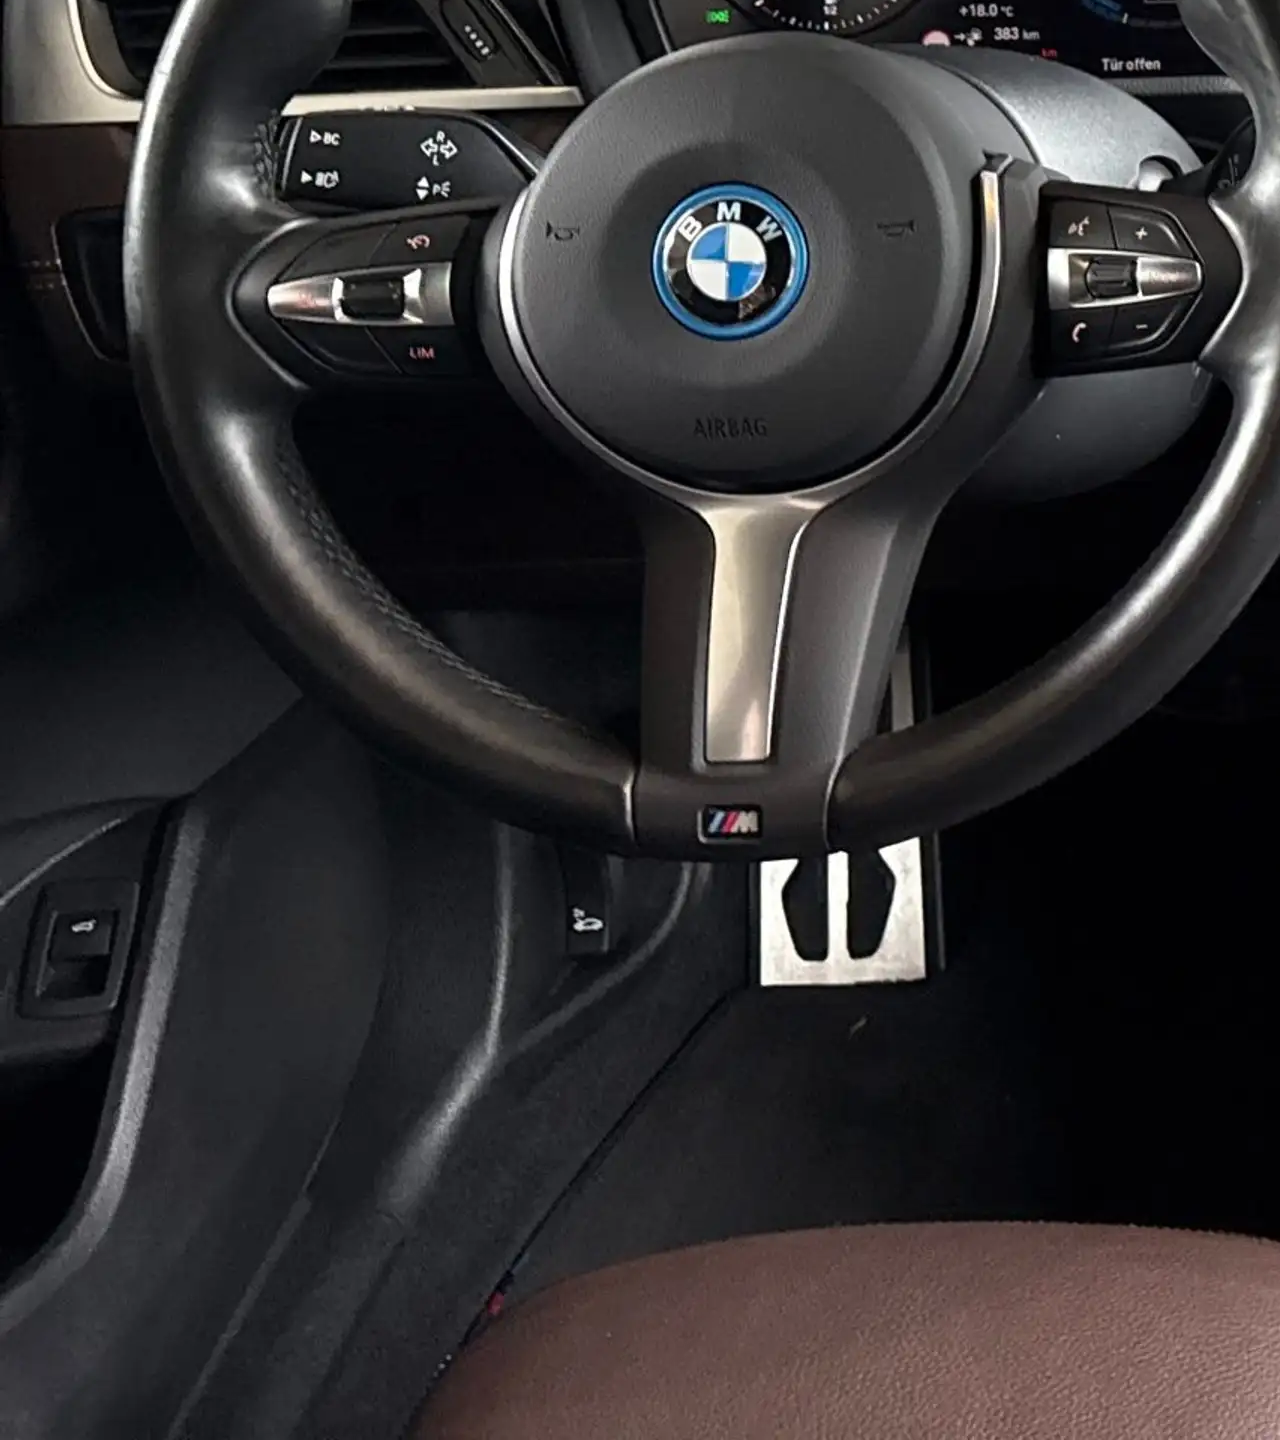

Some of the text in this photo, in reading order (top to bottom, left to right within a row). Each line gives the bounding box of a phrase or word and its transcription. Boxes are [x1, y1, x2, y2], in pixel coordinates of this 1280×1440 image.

[958, 4, 998, 18] +18.0
[993, 27, 1041, 41] 383 km
[1101, 57, 1162, 72] Tür offen
[678, 201, 783, 243] BMW
[409, 346, 435, 359] LIM
[692, 415, 769, 440] AIRBAG
